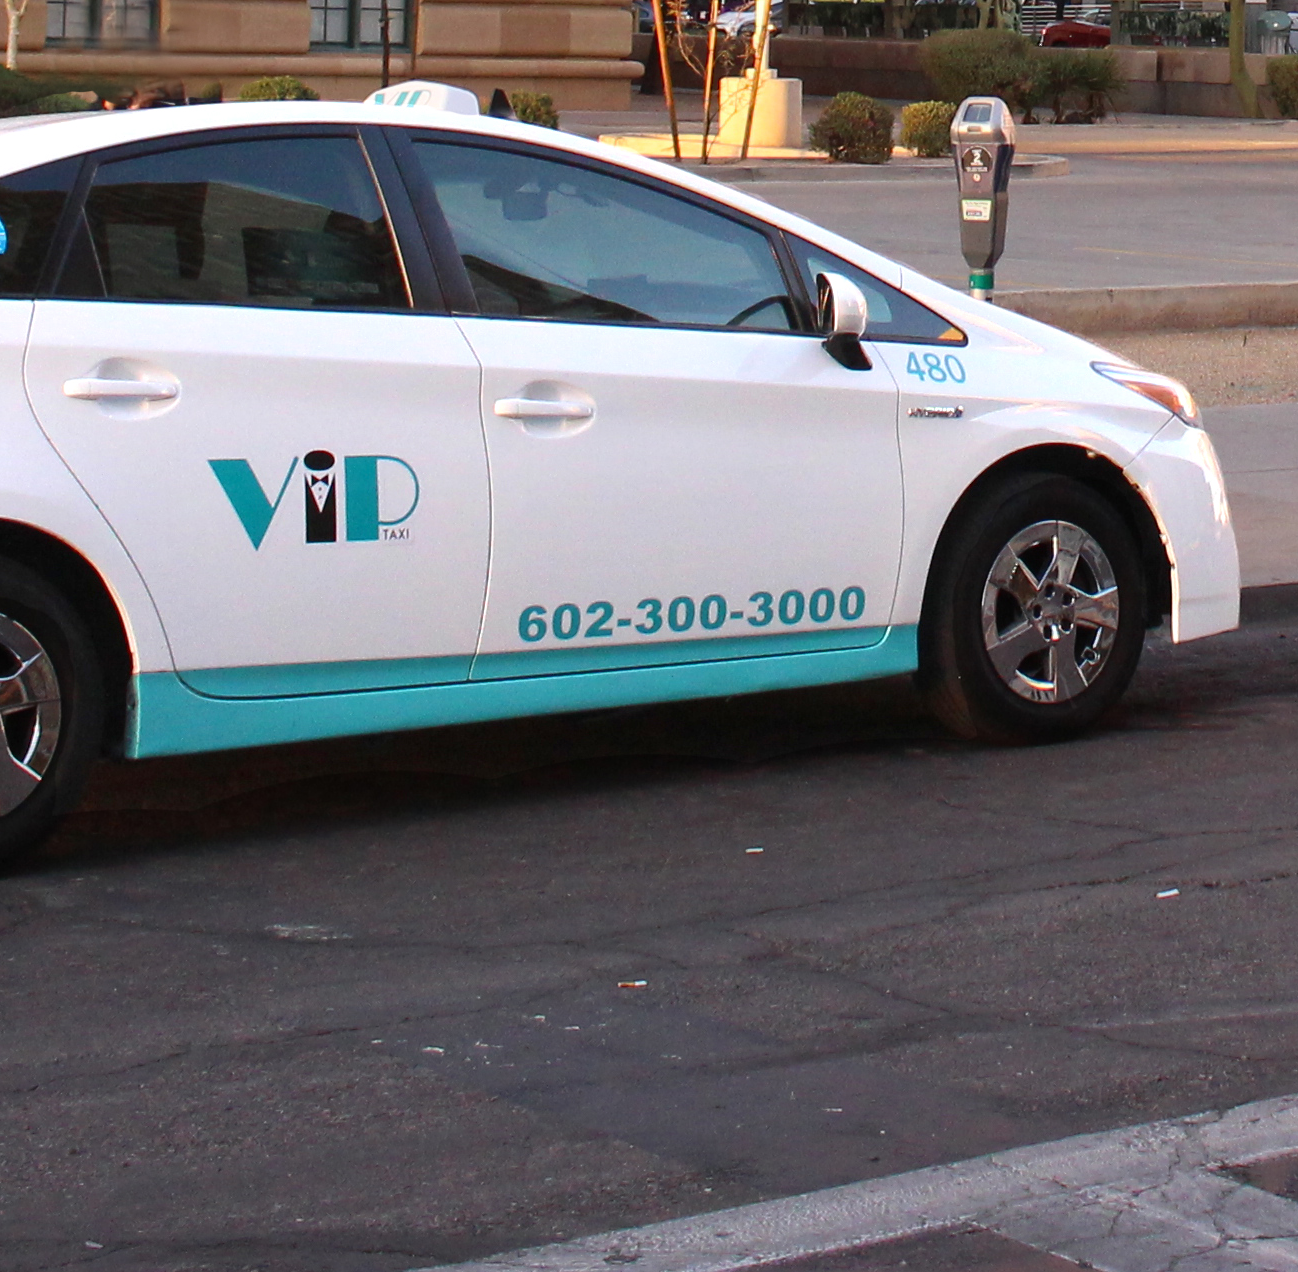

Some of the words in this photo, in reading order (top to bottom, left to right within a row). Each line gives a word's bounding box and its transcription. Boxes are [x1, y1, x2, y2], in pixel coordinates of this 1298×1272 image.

[906, 351, 967, 384] 480
[383, 528, 410, 541] TAXI
[517, 586, 867, 643] 602-300-3000
